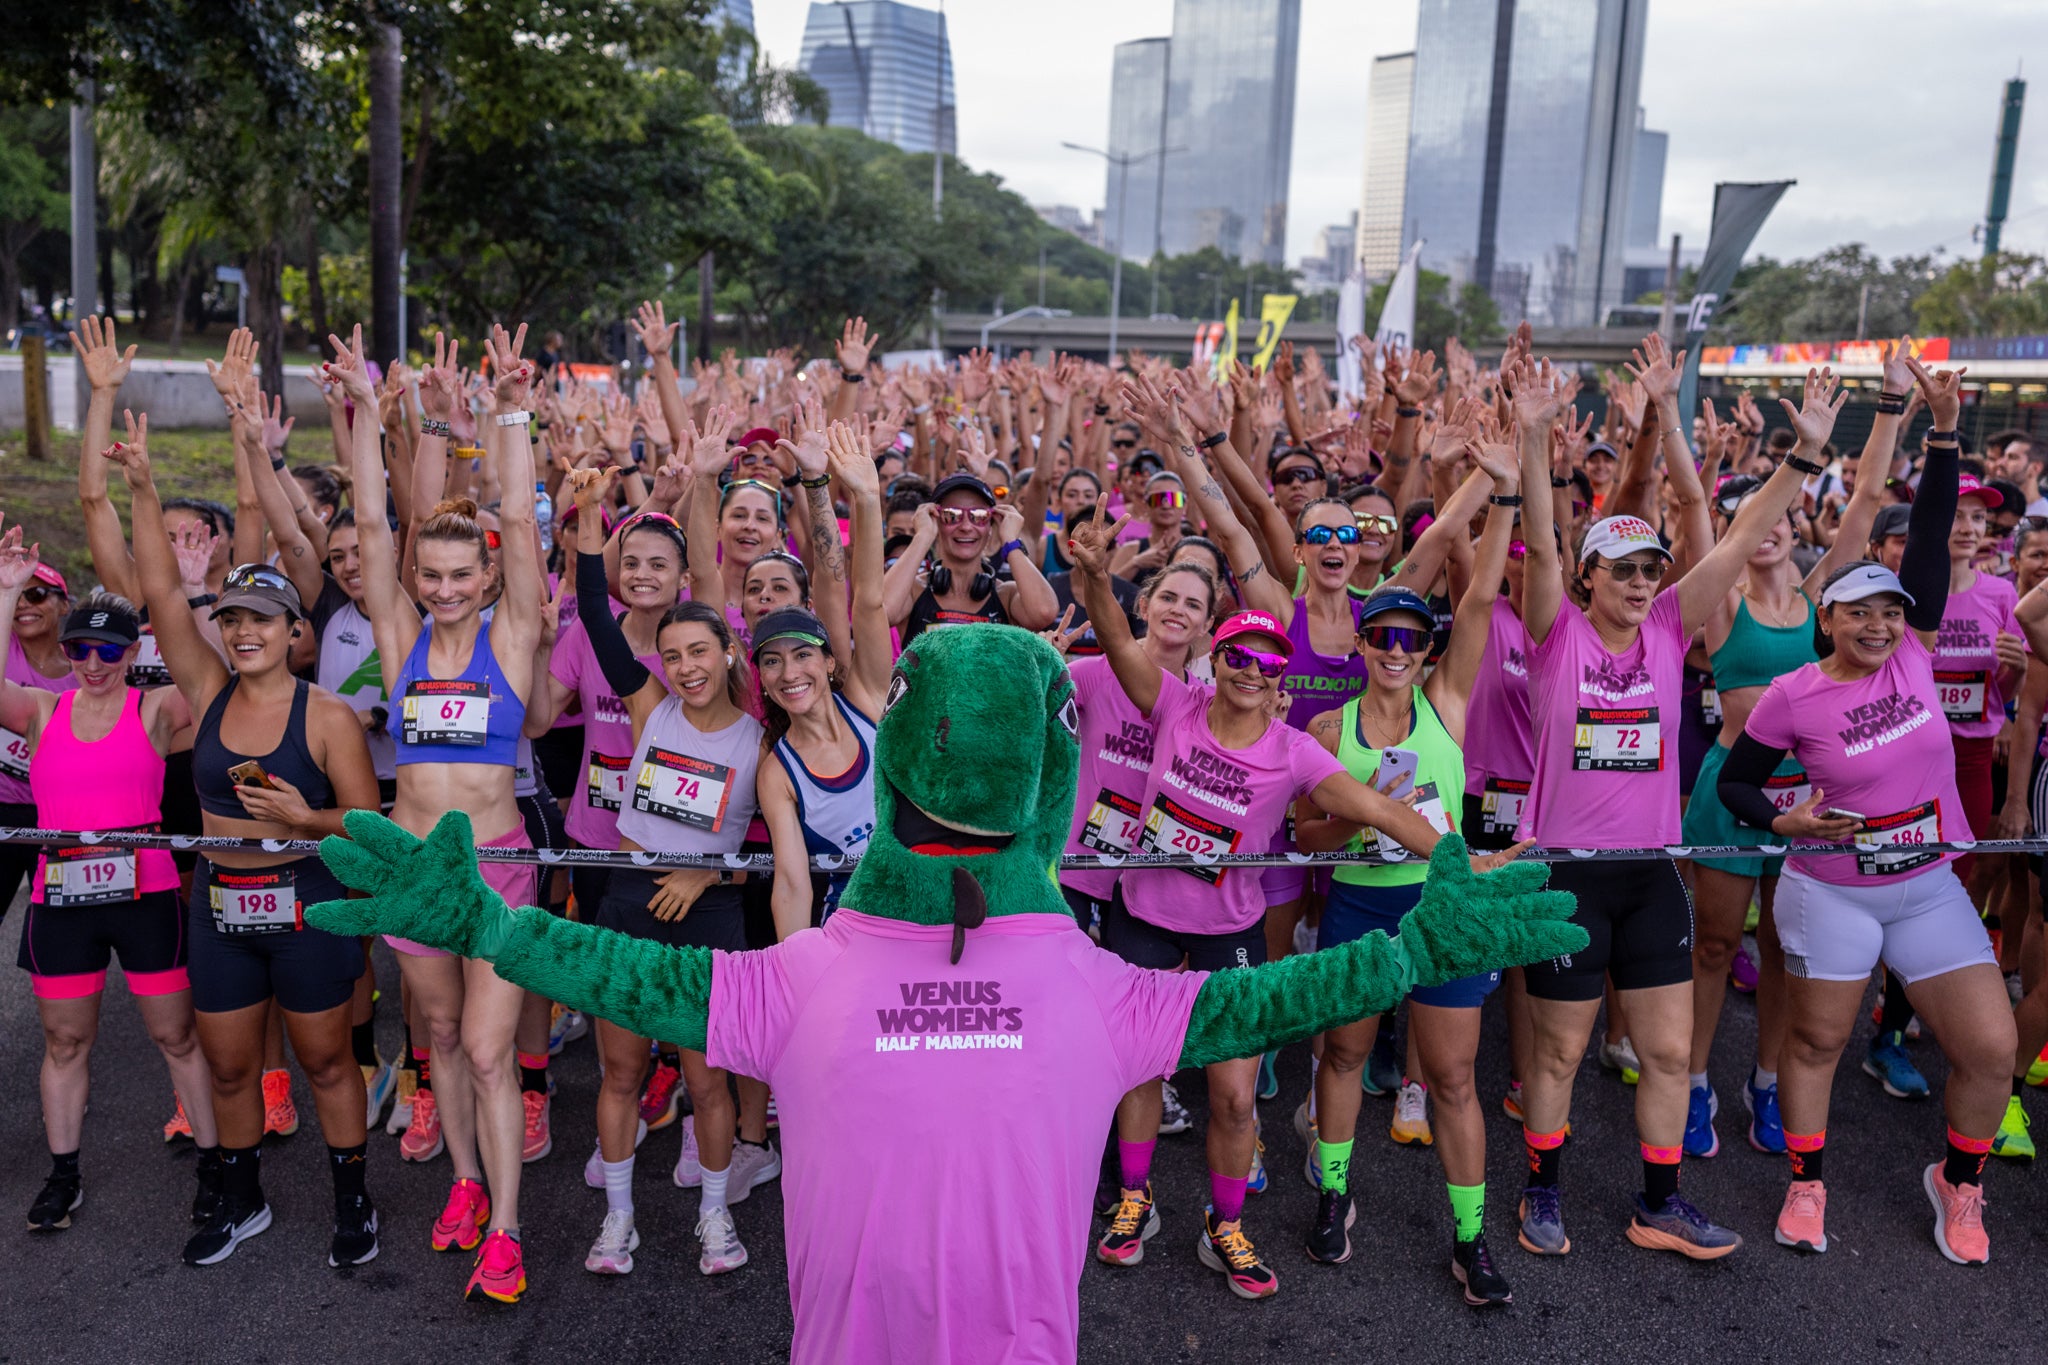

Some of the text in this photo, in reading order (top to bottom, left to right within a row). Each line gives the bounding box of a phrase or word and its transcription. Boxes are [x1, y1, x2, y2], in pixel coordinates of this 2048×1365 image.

[1609, 518, 1646, 534] RUN
[1241, 613, 1275, 631] Jeep
[1939, 619, 1980, 633] ENUS
[1936, 634, 1991, 648] OMEN'S
[1940, 647, 1992, 657] MARATHON
[1284, 675, 1362, 692] STUDIO M
[1940, 687, 1972, 704] 189
[440, 700, 467, 719] 67
[595, 712, 619, 724] HALF
[1838, 694, 1925, 746] WOMEN'S
[1121, 720, 1154, 746] VEN
[1580, 727, 1589, 744] A
[1617, 729, 1641, 748] 72
[1845, 709, 1932, 758] HALF MARATHON
[1099, 749, 1151, 773] HALF MARA
[1190, 746, 1250, 785] VENUS
[642, 767, 651, 784] A
[1171, 755, 1255, 806] WOMEN'S
[674, 776, 700, 800] 74
[1162, 770, 1248, 817] HALF MARATHON
[1774, 791, 1795, 809] 68
[1171, 828, 1214, 854] 202
[1891, 826, 1925, 844] 186
[291, 842, 320, 850] SPOR
[568, 853, 611, 861] SPORTS
[661, 855, 703, 864] SPORTS
[51, 868, 59, 881] A
[82, 862, 116, 883] 119
[237, 893, 277, 914] 198
[900, 981, 1002, 1006] VENUS
[876, 1007, 1023, 1034] WOMEN'S
[875, 1034, 1023, 1052] HALF MARATHON
